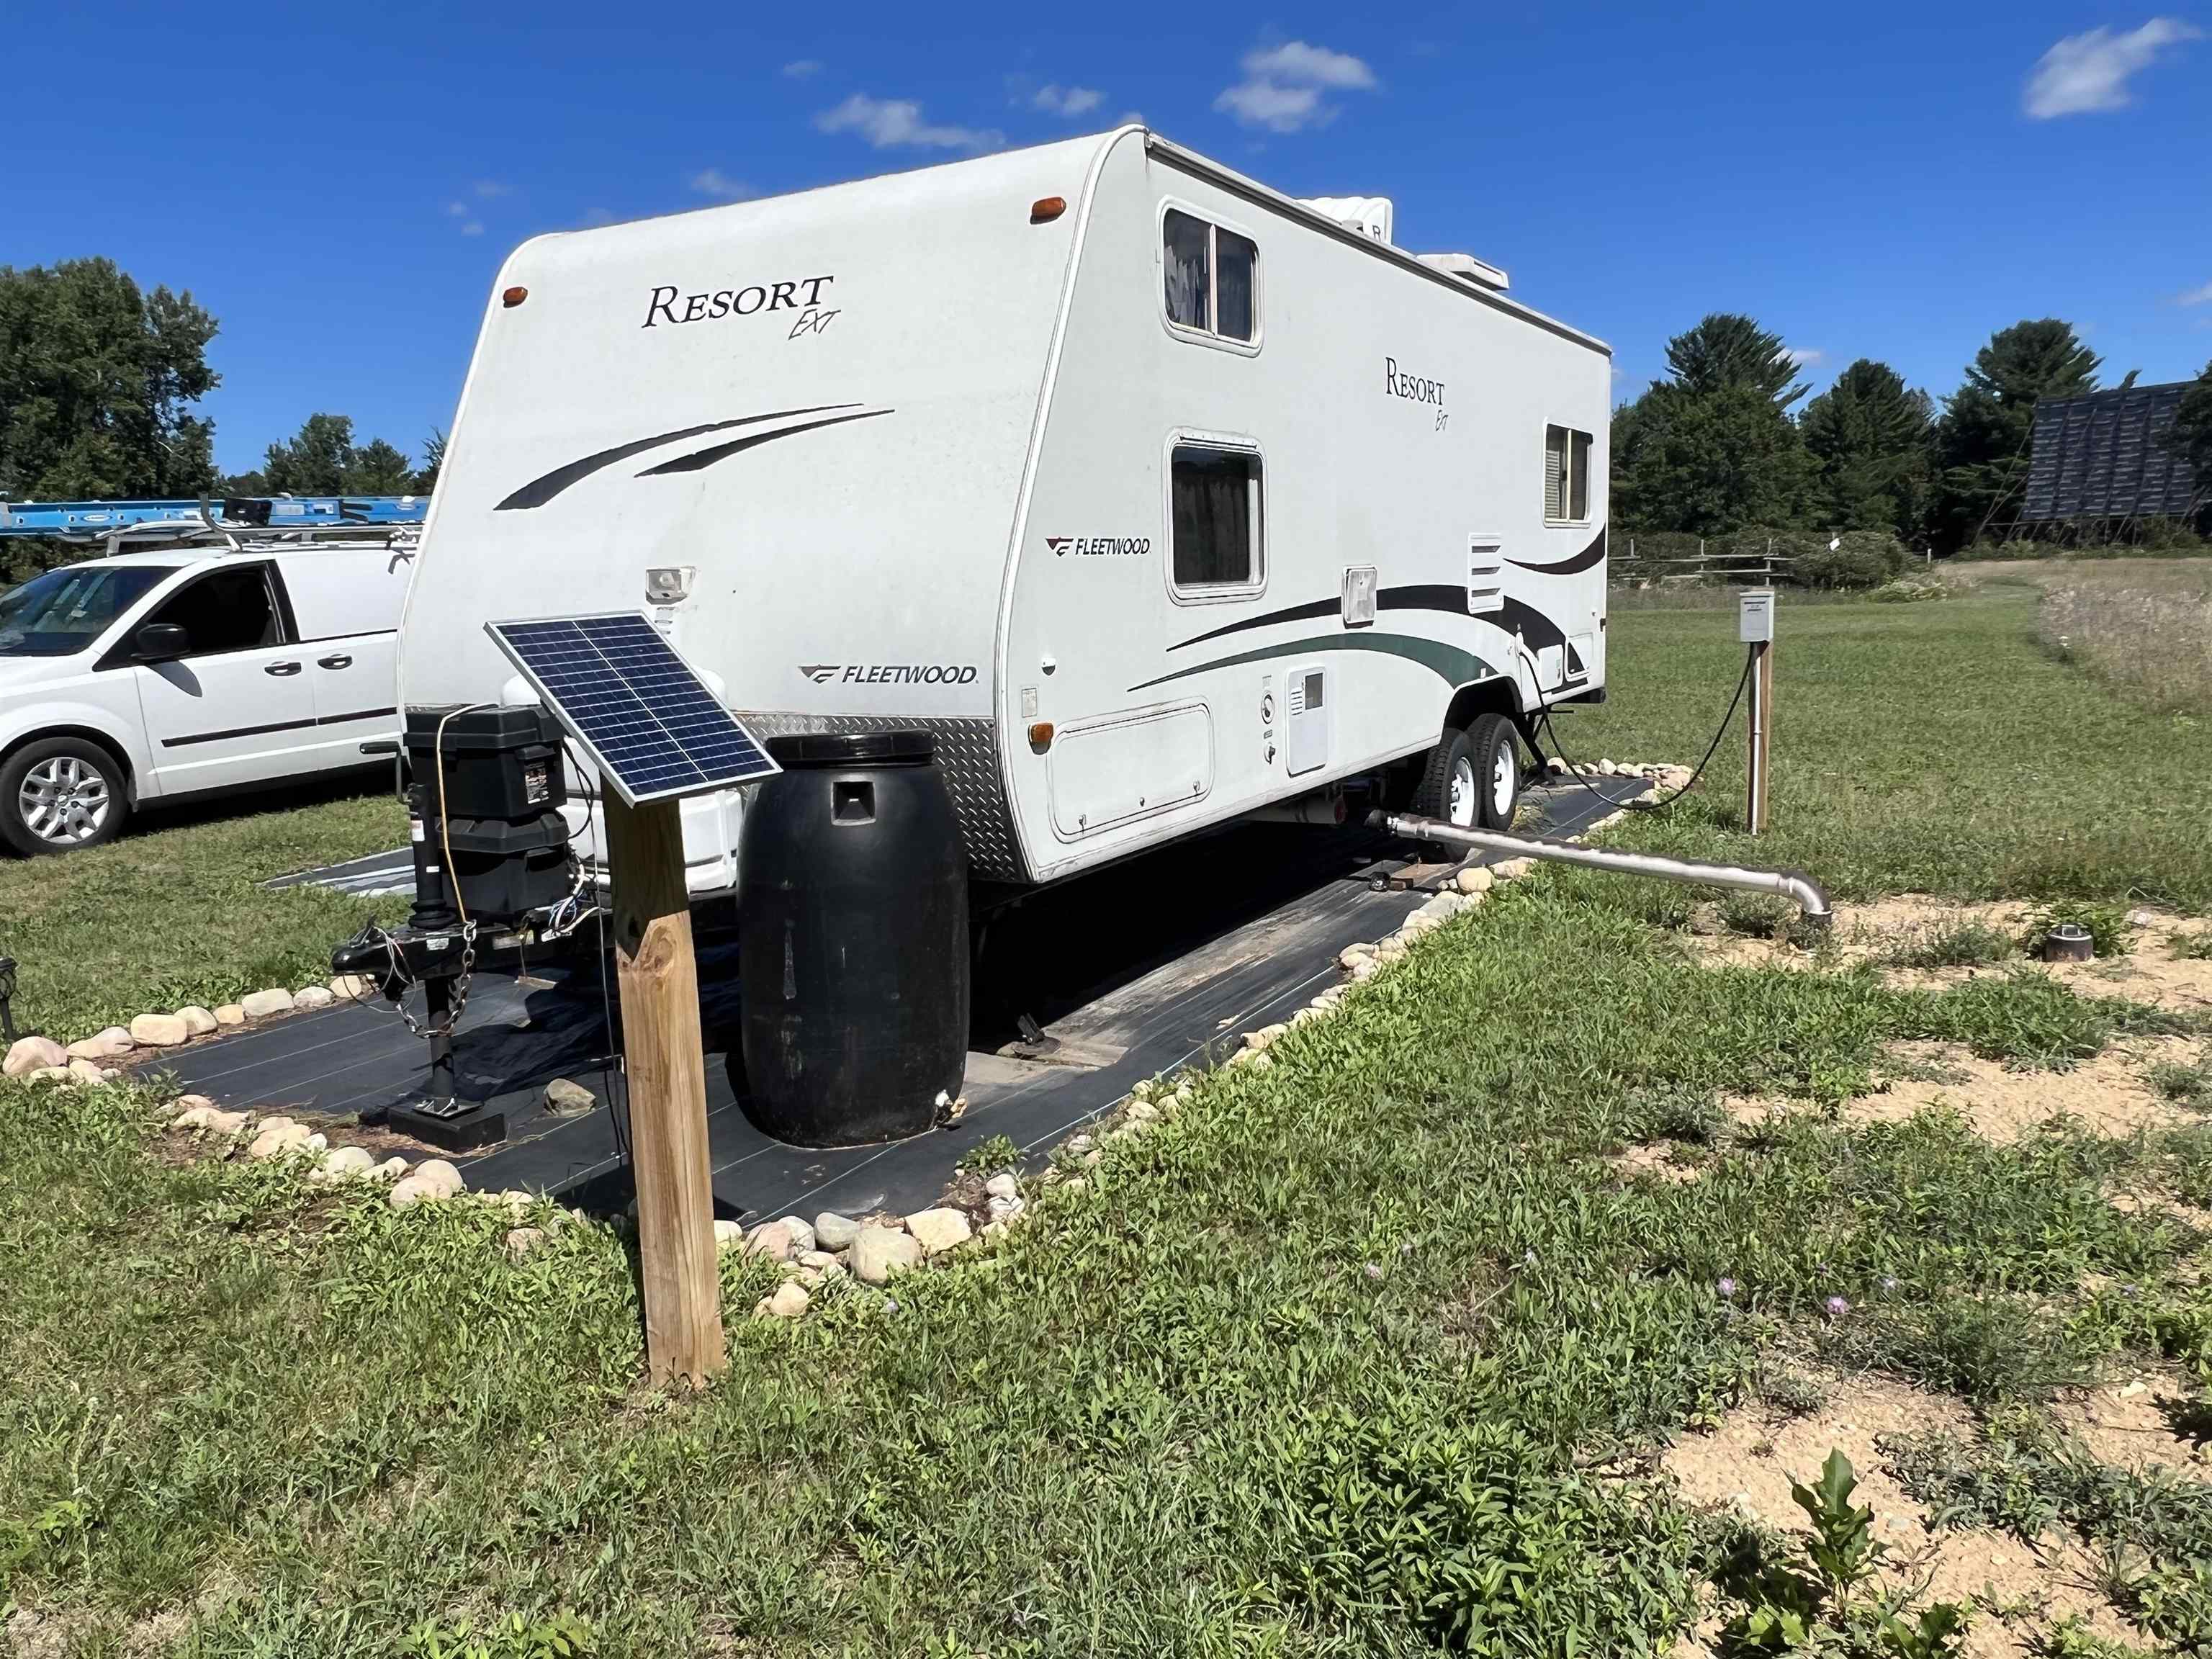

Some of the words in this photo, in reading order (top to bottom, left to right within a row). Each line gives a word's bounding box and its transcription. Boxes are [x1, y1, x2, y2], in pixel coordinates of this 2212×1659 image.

[788, 309, 841, 340] EXT
[1075, 538, 1150, 555] FLEETWOOD
[842, 665, 976, 684] FLEETWOOD
